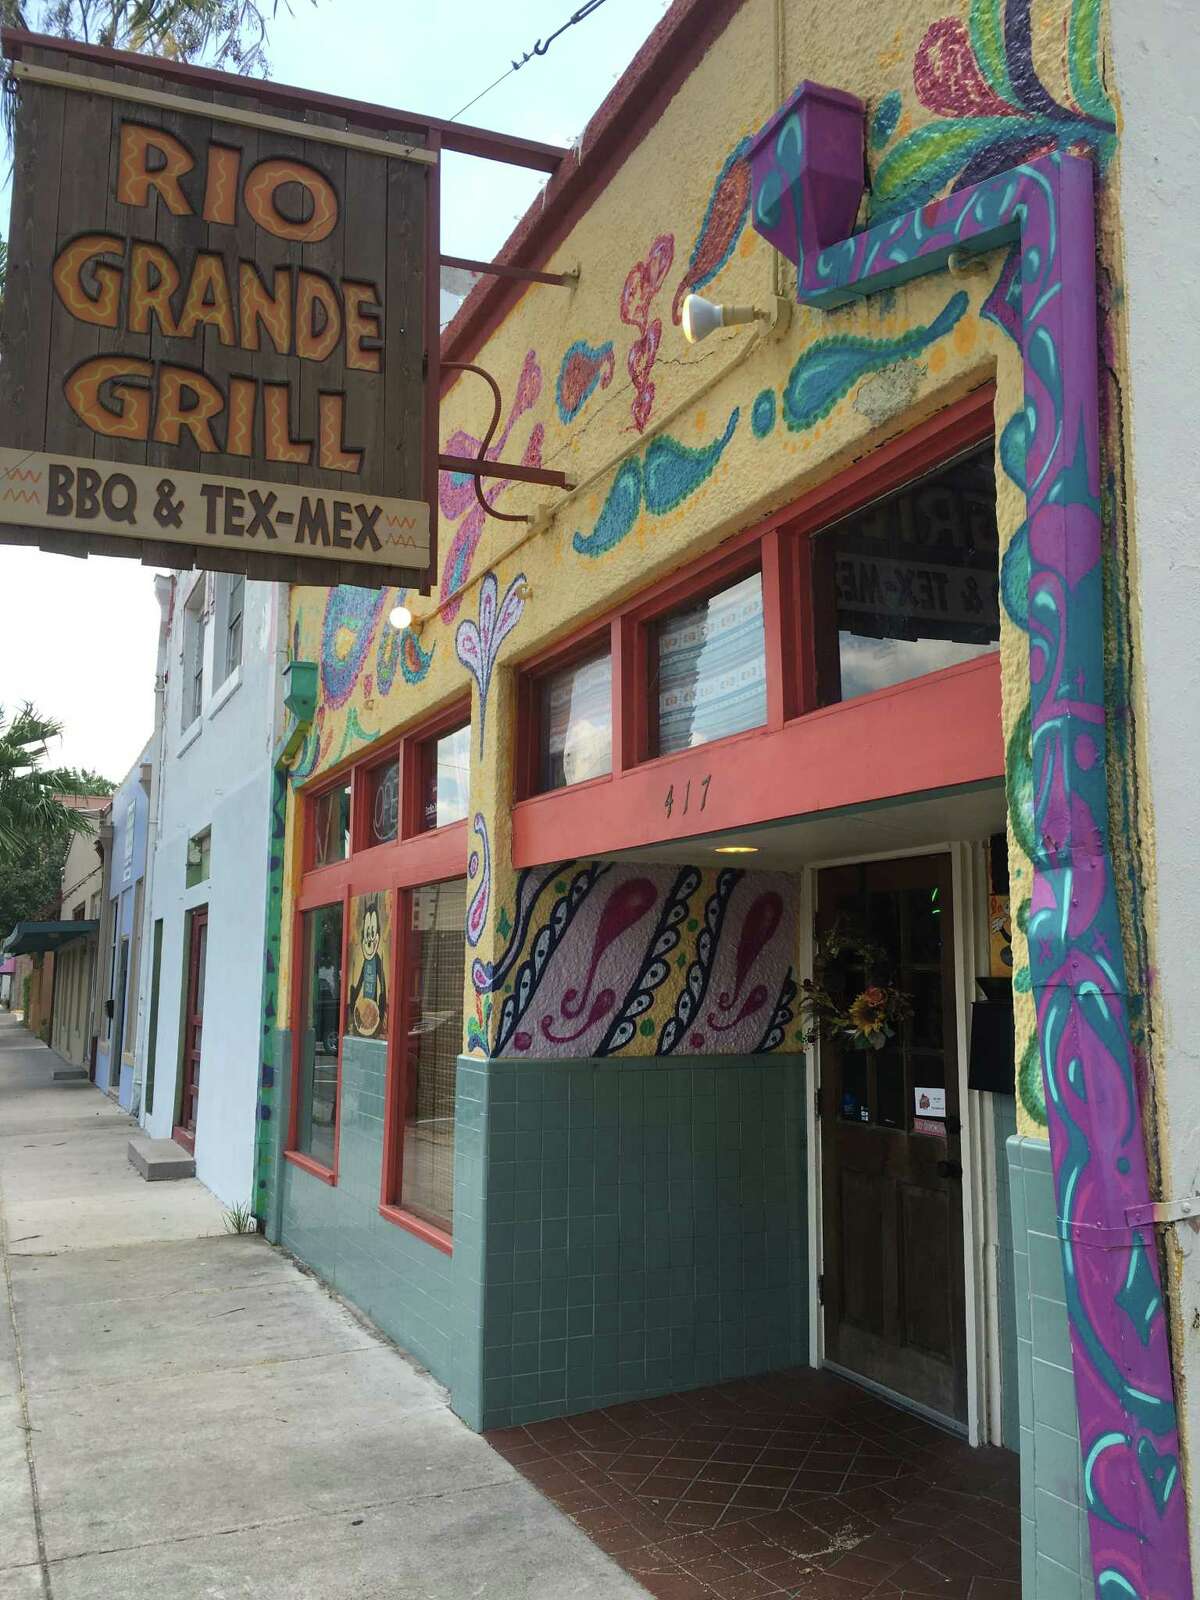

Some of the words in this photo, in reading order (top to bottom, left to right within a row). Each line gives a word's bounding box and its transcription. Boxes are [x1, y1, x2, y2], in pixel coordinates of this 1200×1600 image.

[117, 119, 339, 243] RIO
[53, 232, 383, 372] GRANDE
[63, 355, 366, 474] GRILL
[46, 464, 137, 525] BBQ
[153, 478, 185, 529] &
[200, 484, 384, 552] TEX-MEX
[665, 774, 712, 819] 417
